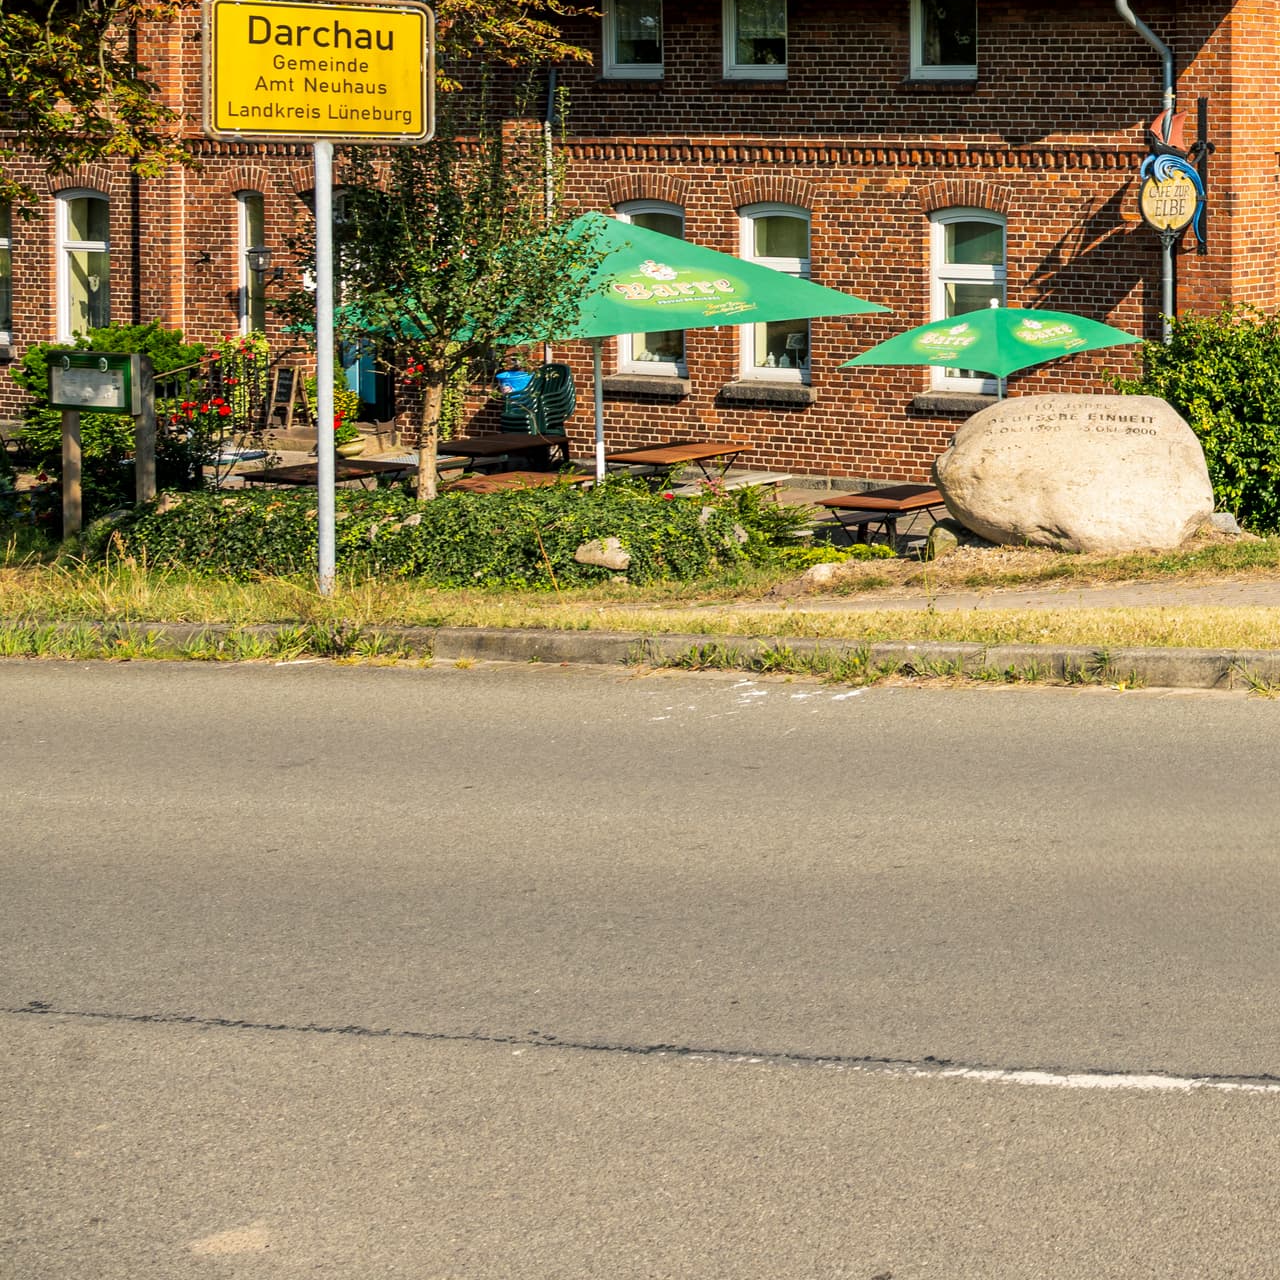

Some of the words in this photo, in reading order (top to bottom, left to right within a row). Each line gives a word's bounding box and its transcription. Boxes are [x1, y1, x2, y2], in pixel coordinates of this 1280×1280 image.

[248, 15, 394, 51] Darchau
[273, 54, 369, 73] Gemeinde
[254, 76, 295, 93] Amt
[304, 77, 387, 95] Neuhaus
[228, 101, 321, 120] Landkreis
[328, 103, 412, 125] Lüneburg
[1174, 185, 1190, 197] ZUR
[1155, 199, 1187, 217] ELBE
[612, 279, 735, 300] Barre
[1087, 413, 1156, 424] EINHEIT
[1125, 426, 1157, 436] 2000
